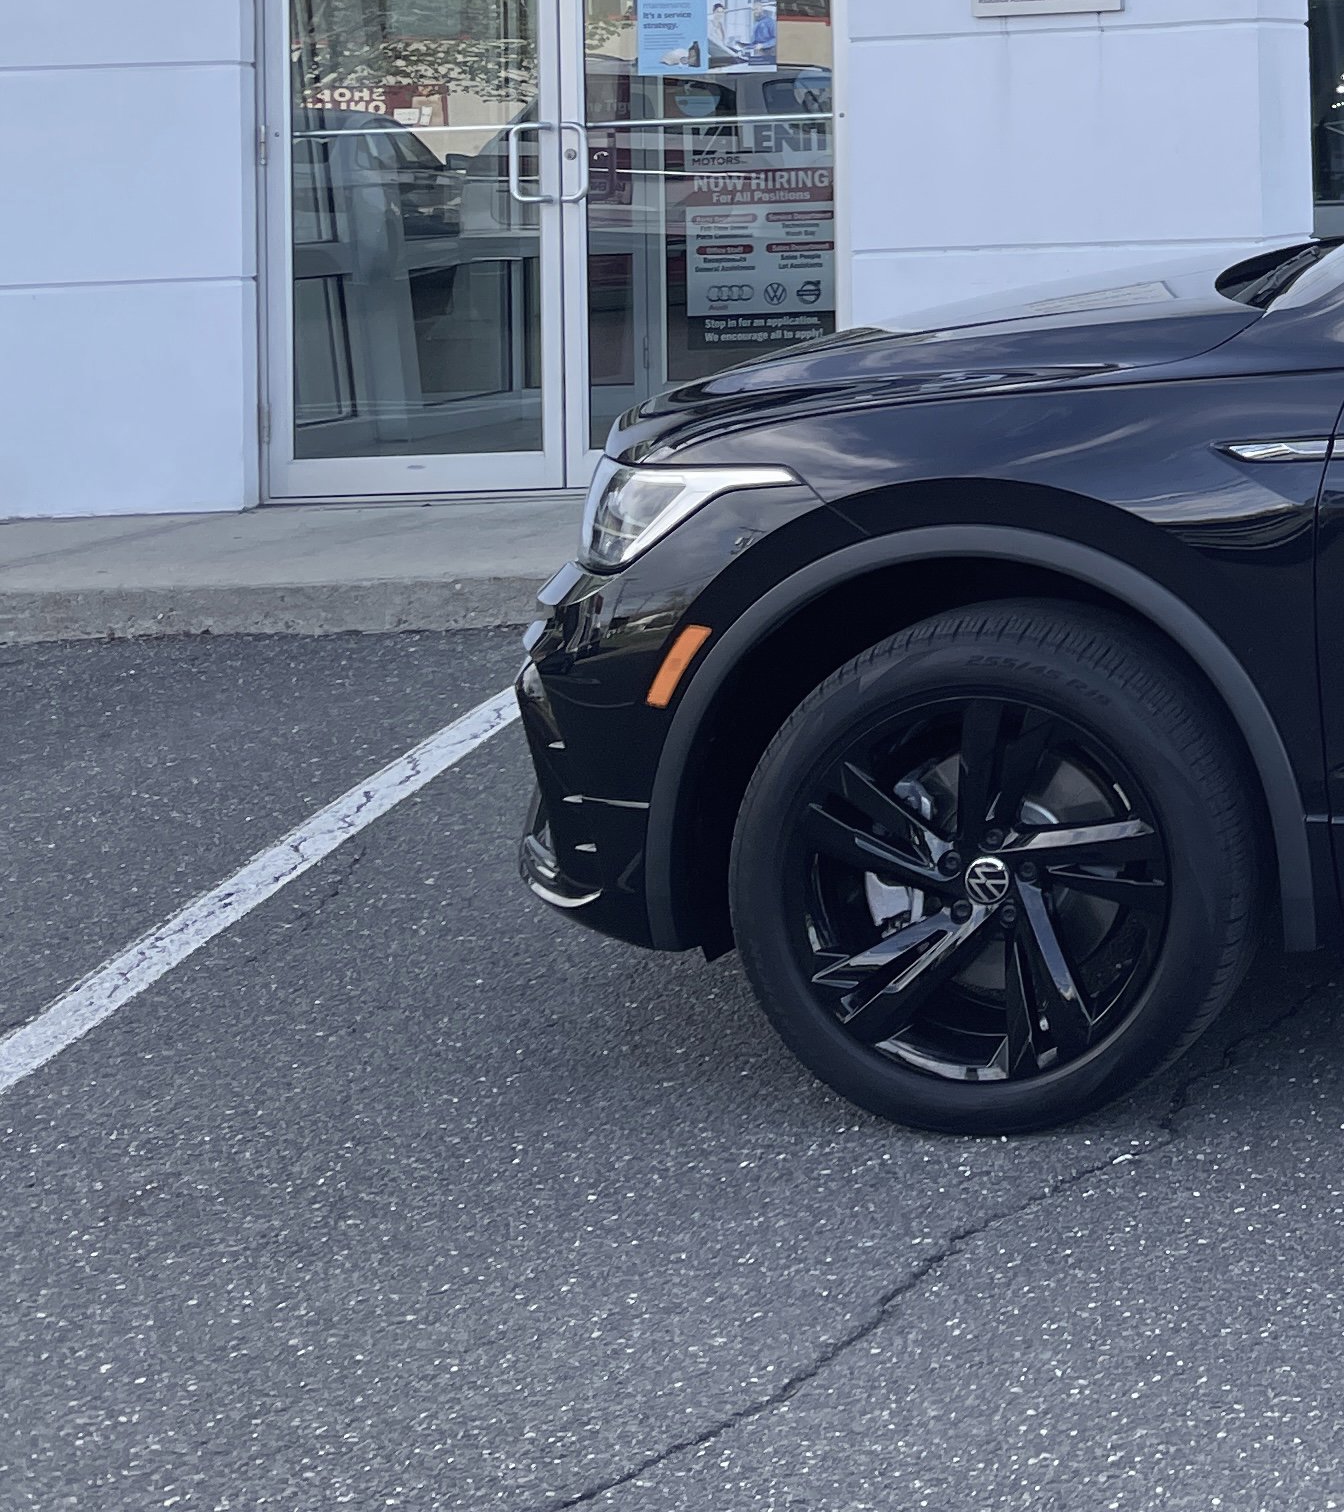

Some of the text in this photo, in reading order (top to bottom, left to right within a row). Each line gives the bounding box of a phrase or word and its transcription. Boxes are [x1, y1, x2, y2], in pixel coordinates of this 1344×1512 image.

[643, 11, 655, 19] It's
[664, 11, 692, 19] service
[643, 22, 679, 30] strategy.
[692, 156, 740, 166] MOTORS
[694, 169, 830, 192] NOW HIRING
[712, 190, 811, 203] For All Positions
[705, 316, 821, 329] Stop in for an application.
[704, 328, 823, 342] We encourage all to apply!
